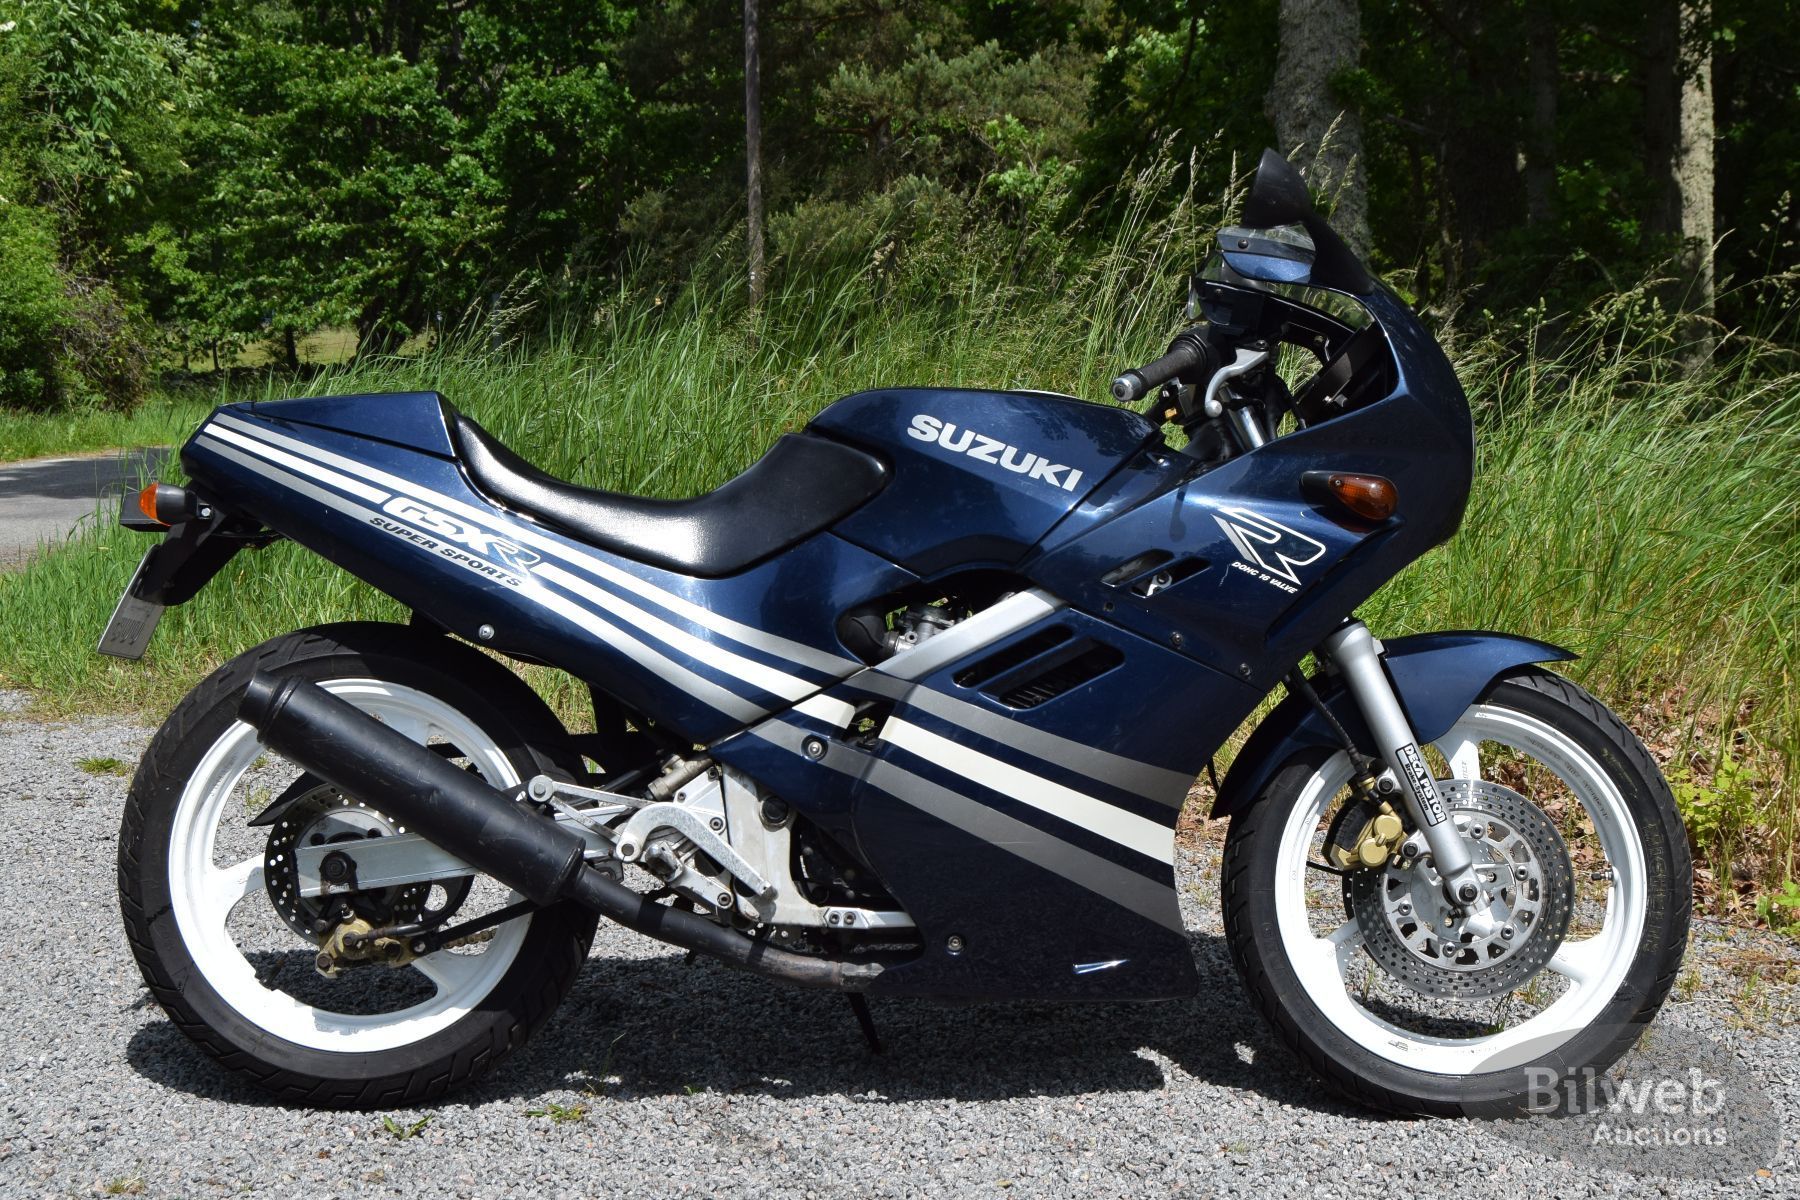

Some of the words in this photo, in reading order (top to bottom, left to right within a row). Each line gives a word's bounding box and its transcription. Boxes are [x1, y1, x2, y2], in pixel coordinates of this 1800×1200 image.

[907, 414, 1083, 492] SUZUKI
[369, 517, 439, 550] SUPER
[440, 548, 522, 586] SPORTS
[1210, 507, 1326, 585] R
[1231, 561, 1259, 576] DOHC
[1258, 573, 1268, 581] 16
[1269, 578, 1298, 594] VALVE
[1404, 744, 1424, 779] DECA
